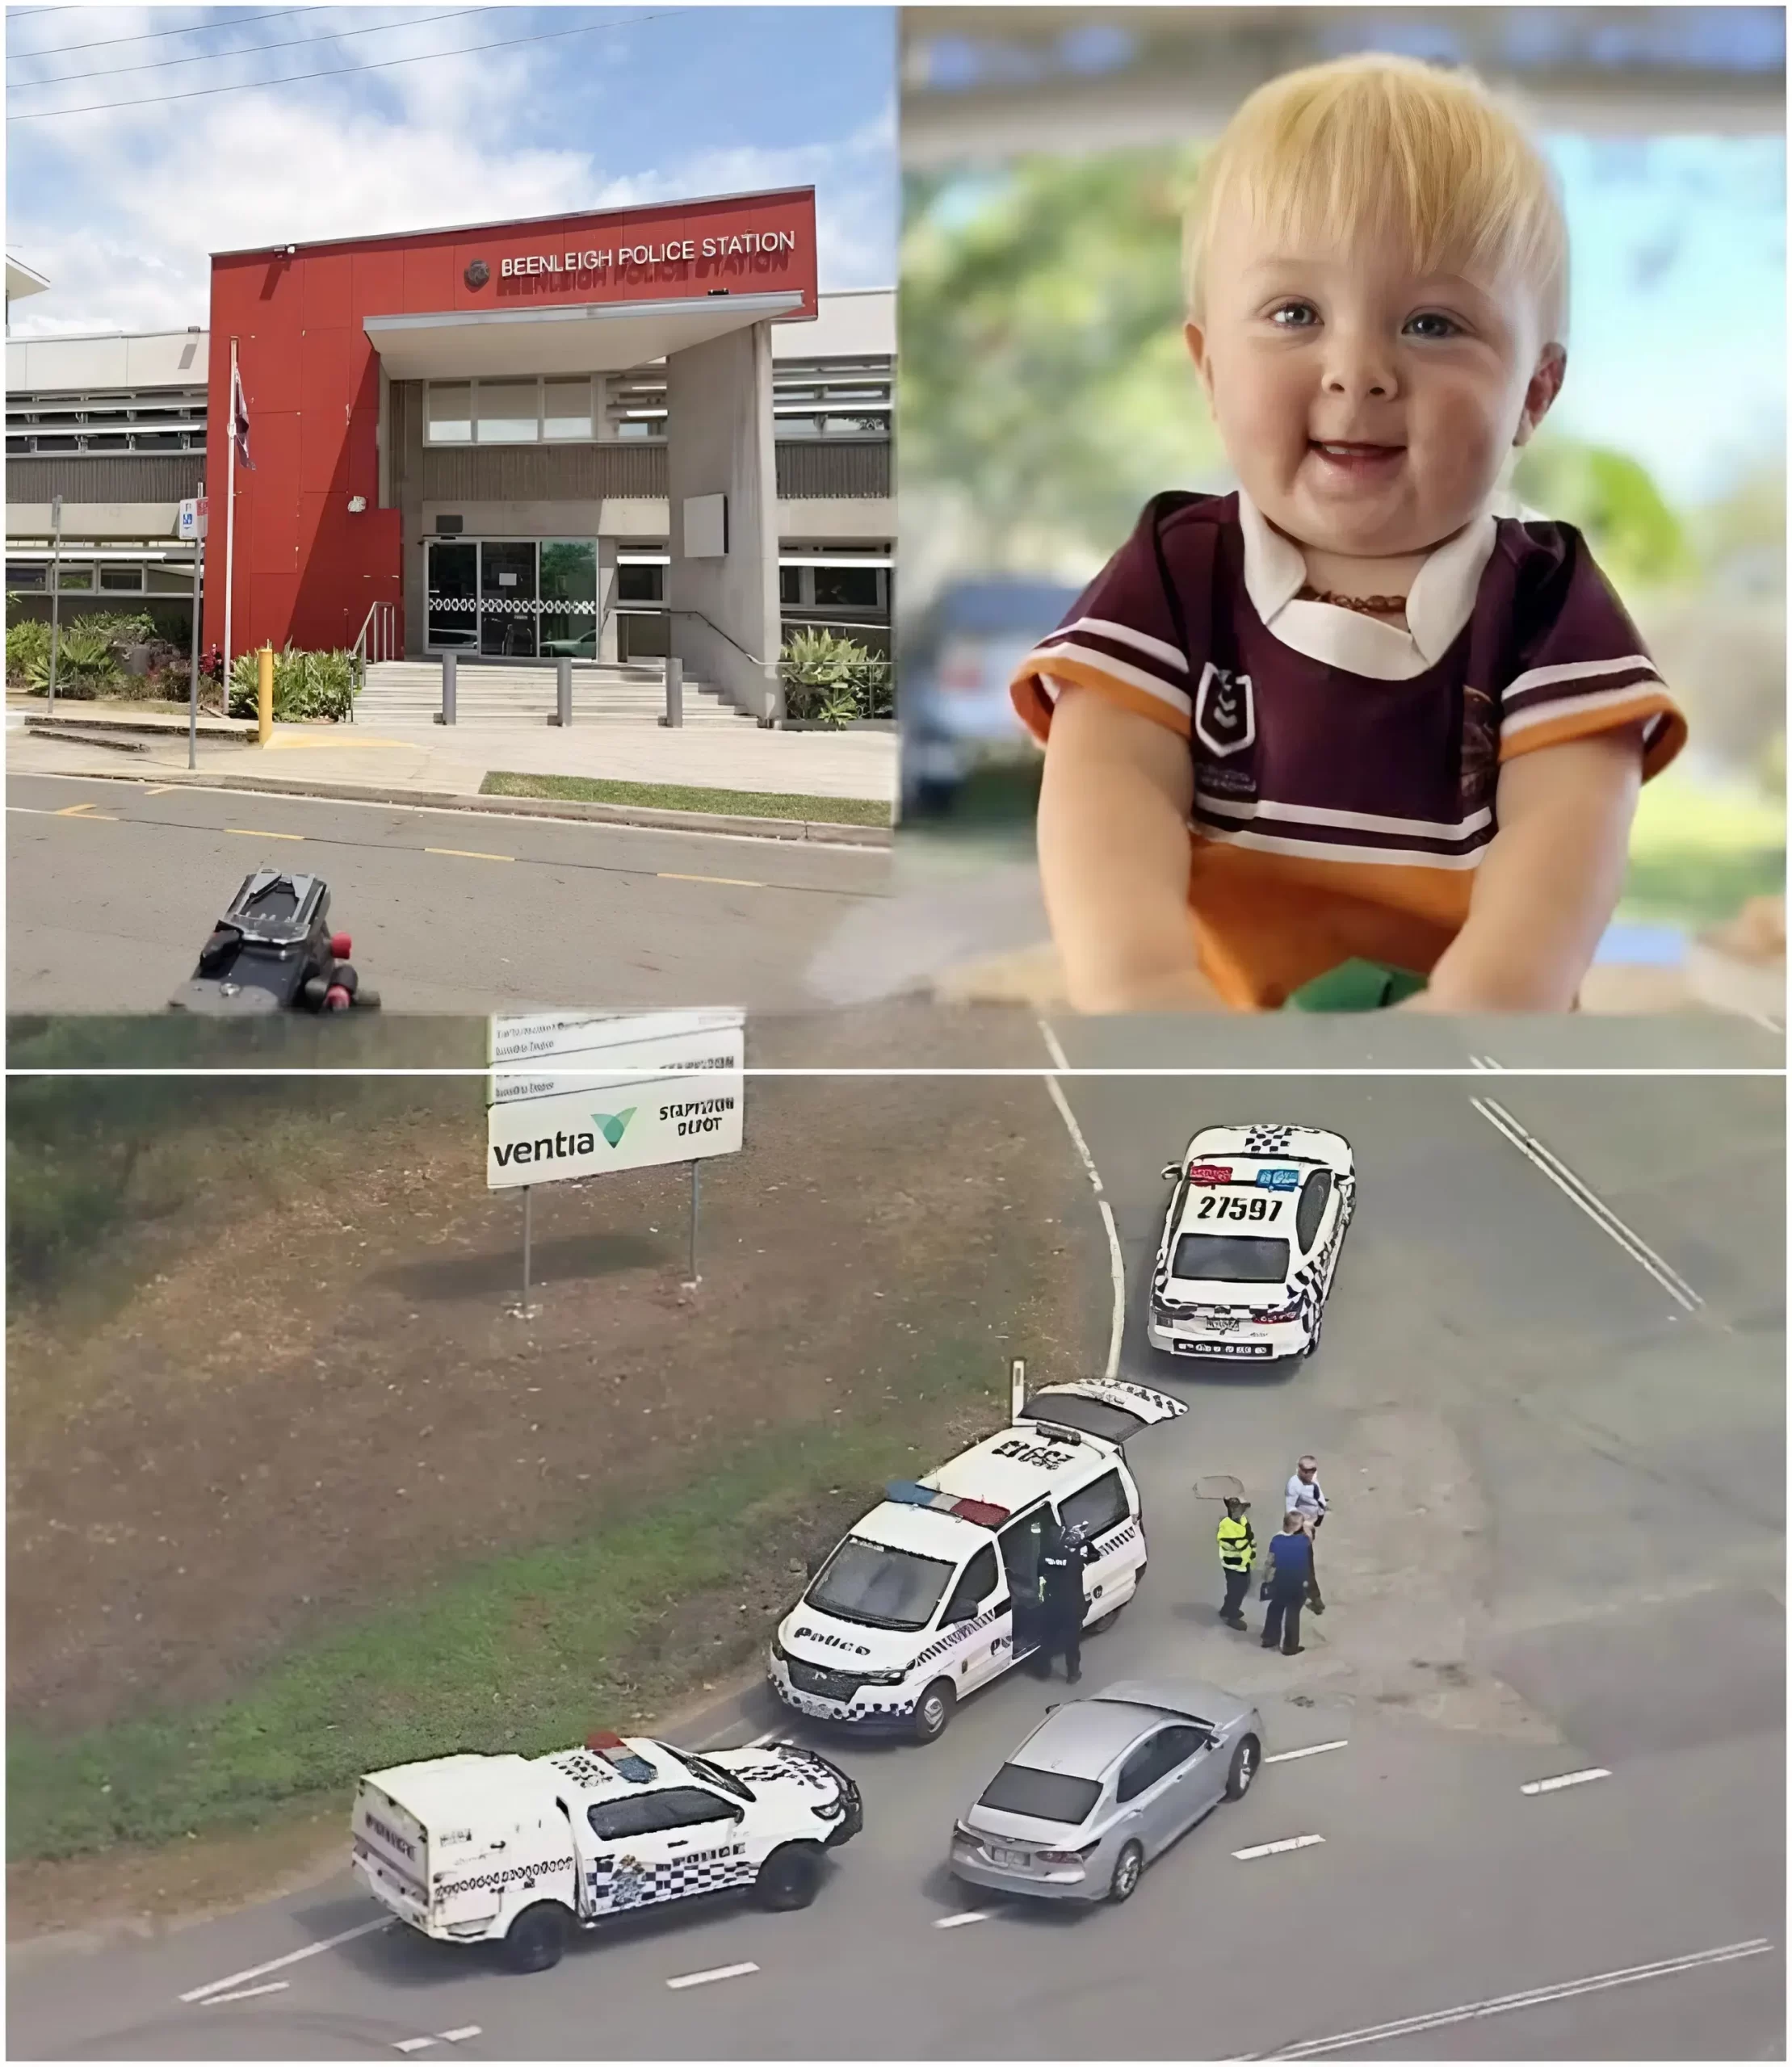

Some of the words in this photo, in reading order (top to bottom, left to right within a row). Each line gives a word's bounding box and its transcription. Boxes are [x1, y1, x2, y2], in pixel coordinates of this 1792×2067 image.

[502, 249, 612, 278] BEENLEIGH
[619, 240, 695, 265] POLICE
[702, 230, 795, 256] STATION
[493, 1130, 594, 1167] ventia
[1197, 1196, 1282, 1222] 27597
